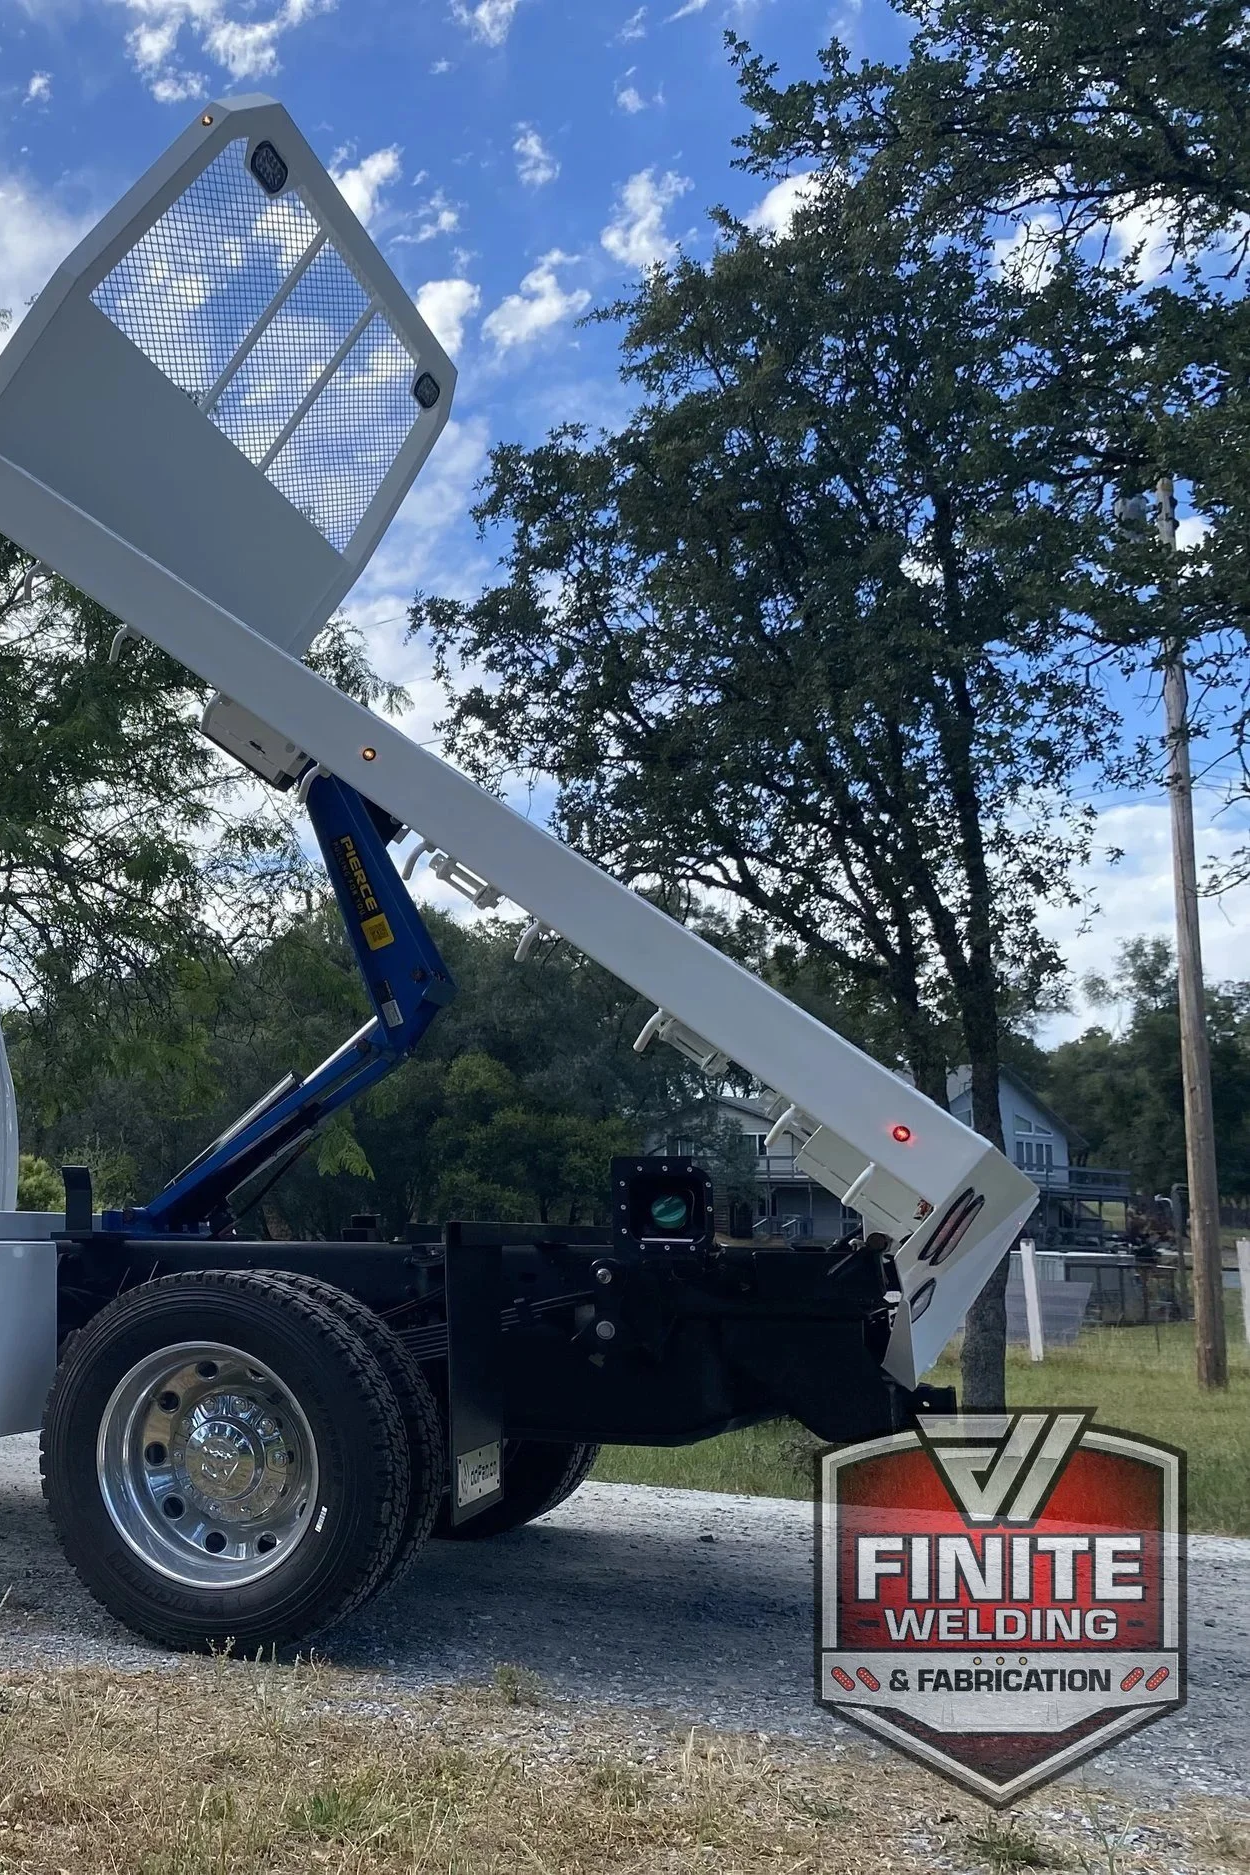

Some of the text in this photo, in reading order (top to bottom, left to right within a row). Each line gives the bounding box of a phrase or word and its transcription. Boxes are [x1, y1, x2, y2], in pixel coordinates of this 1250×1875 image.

[332, 840, 350, 877] PULLING
[356, 898, 366, 916] YOU
[340, 835, 378, 912] PIERCE
